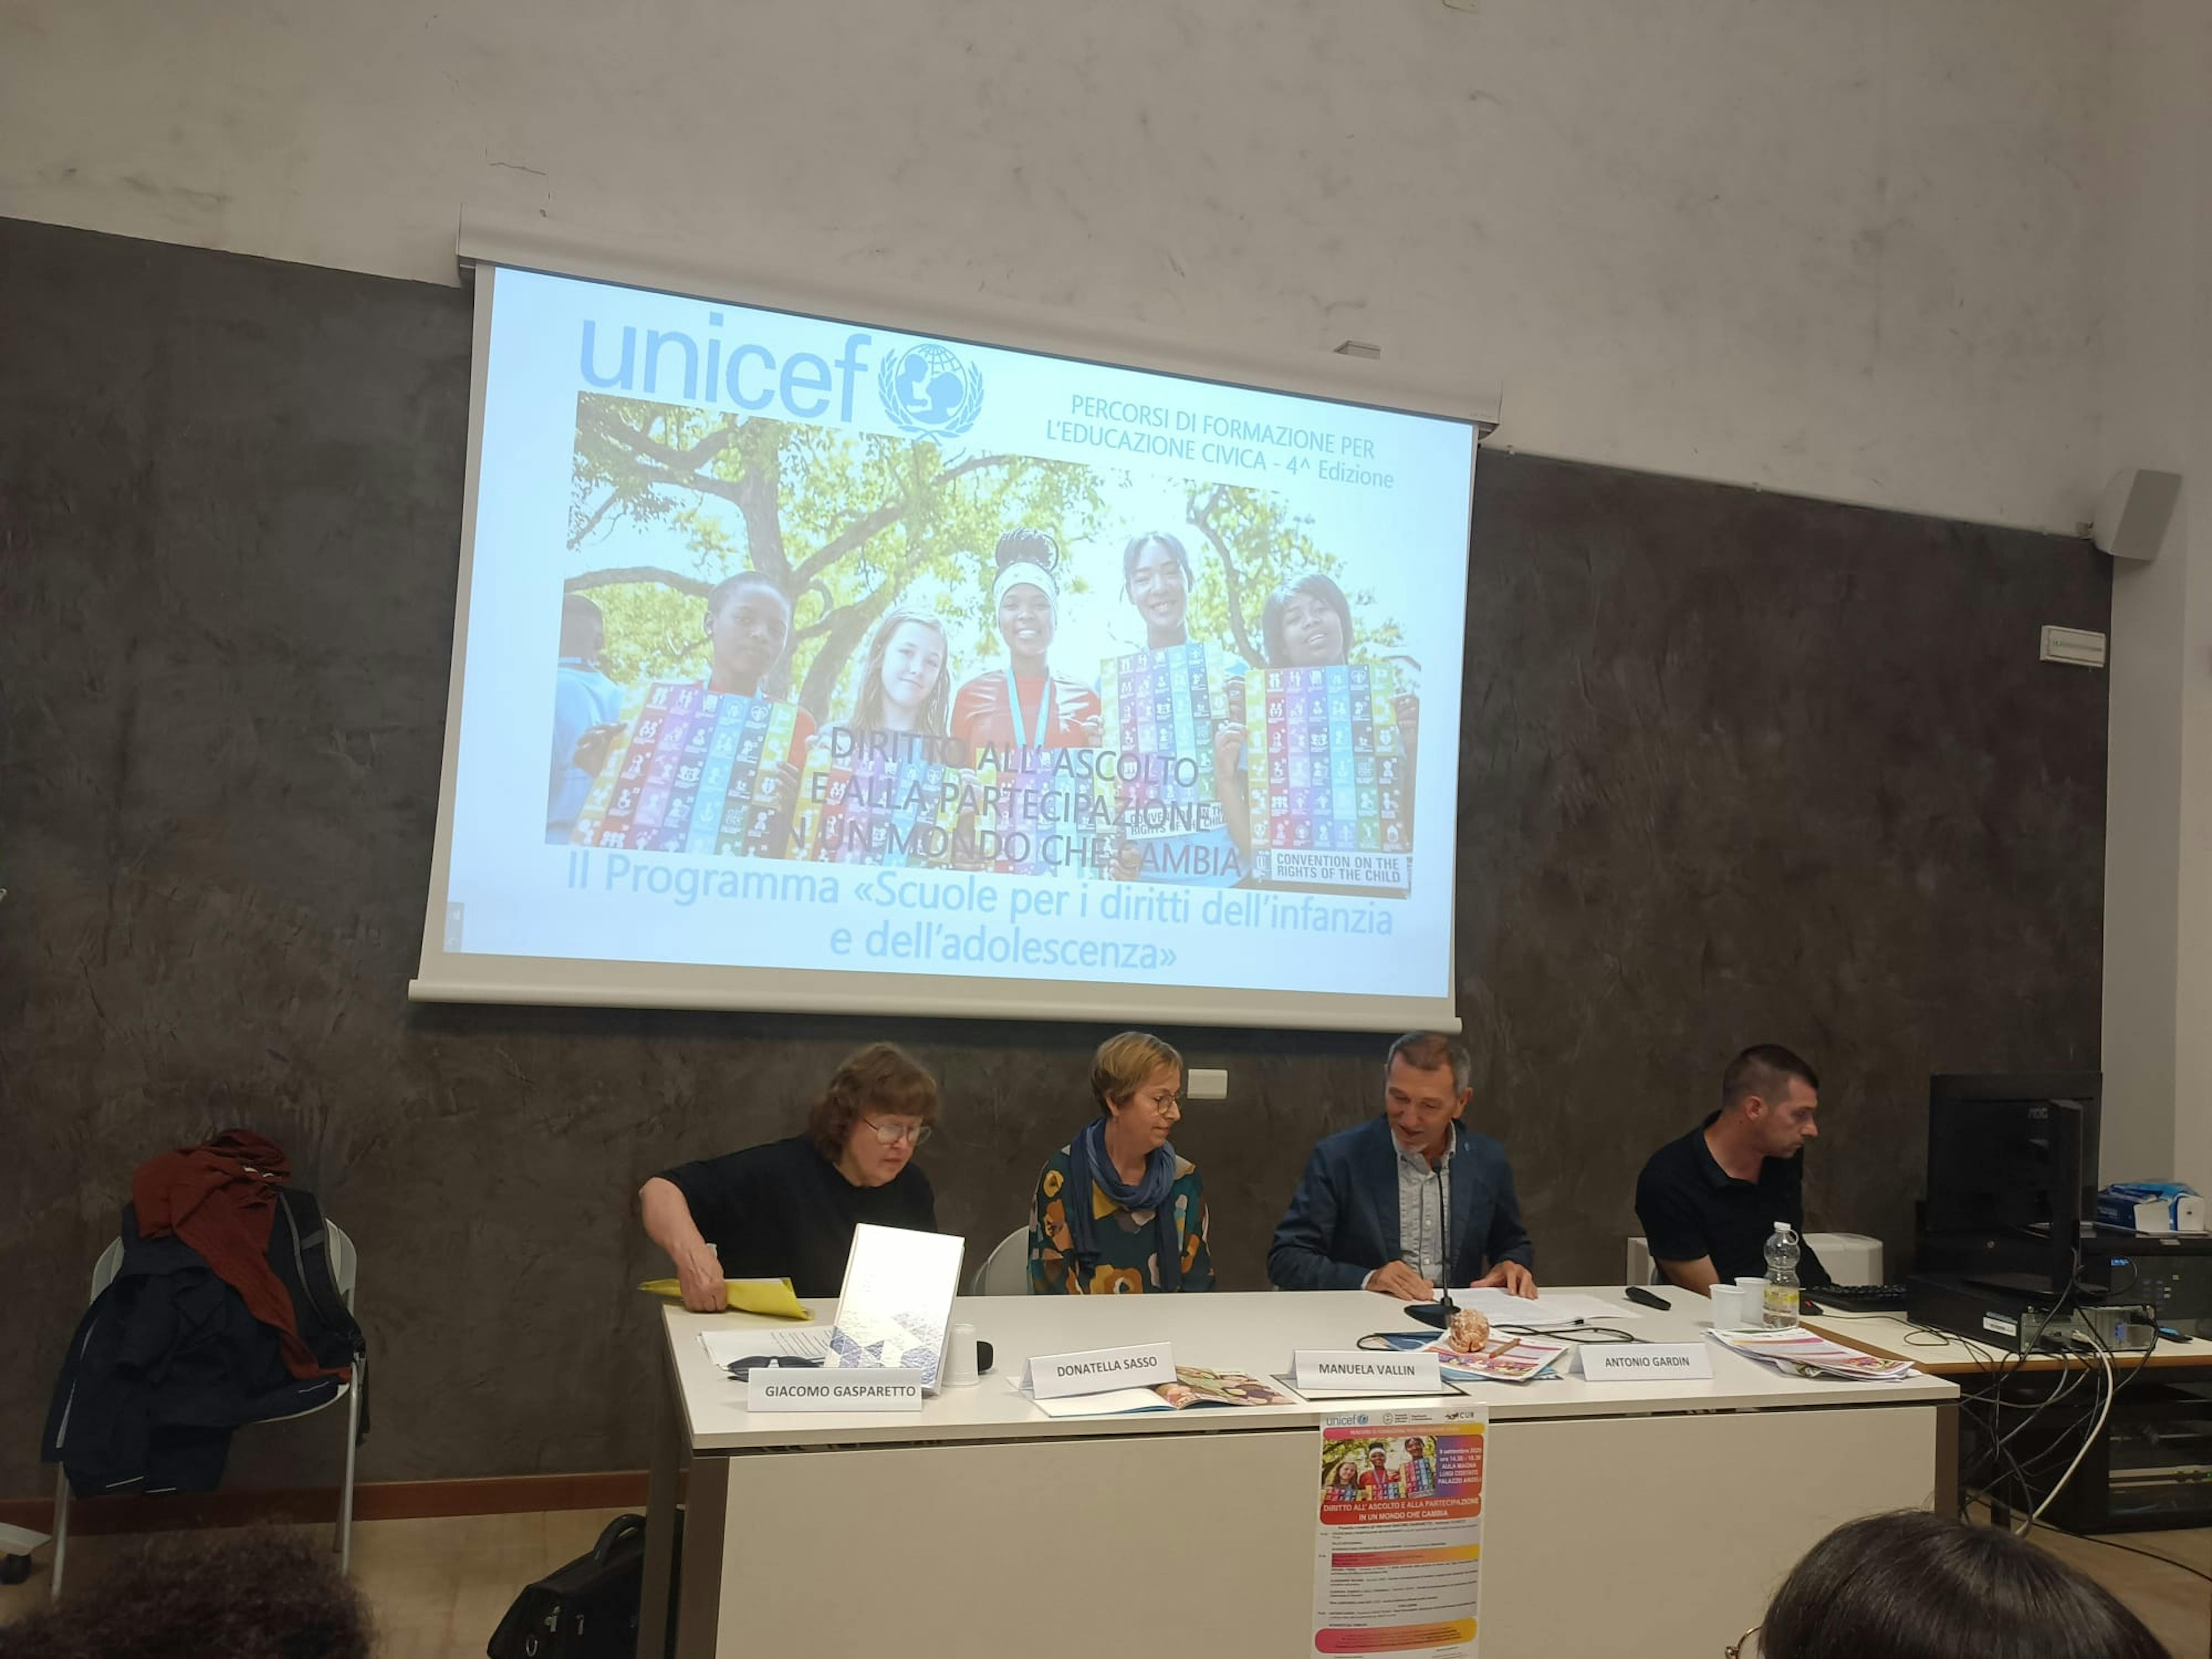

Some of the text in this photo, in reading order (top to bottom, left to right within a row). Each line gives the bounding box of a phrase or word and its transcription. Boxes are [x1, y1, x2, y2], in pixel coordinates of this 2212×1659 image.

[580, 311, 872, 423] unicef
[1071, 394, 1375, 460] PERCORSI DI FORMAZIONE PER
[1046, 420, 1195, 460] L'EDUCAZIONE
[1202, 442, 1266, 471] CIVICA
[1318, 459, 1394, 490] Edizione
[831, 726, 966, 768] DIRITTO
[1053, 747, 1199, 788] ASCOLTO
[811, 772, 827, 804] E
[841, 774, 928, 811] ALLA
[940, 782, 1211, 832] PARTECIPAZIONE
[822, 818, 873, 852] UN
[886, 822, 1030, 862] MONDO
[1042, 834, 1107, 868] CHE
[1277, 853, 1399, 870] CONVENTION ON THE
[1277, 865, 1401, 883] RIGHTS OF THE CHILD
[567, 850, 1394, 936] Il Programma «Scuole per i diritti dell'infanzia
[830, 919, 1177, 970] e dell'adolescenza»
[1056, 1356, 1158, 1378] DONATELLA SASSO
[1318, 1363, 1416, 1376] MANUELA VALLIN
[1605, 1356, 1691, 1368] ANTONIO GARDIN
[765, 1385, 916, 1398] GIACOMO GASPARETTO
[1326, 1414, 1357, 1426] unicef
[1368, 1502, 1400, 1510] ASCOLTO
[1425, 1497, 1479, 1507] PARTECIPAZIONE
[1378, 1512, 1405, 1520] MONDO
